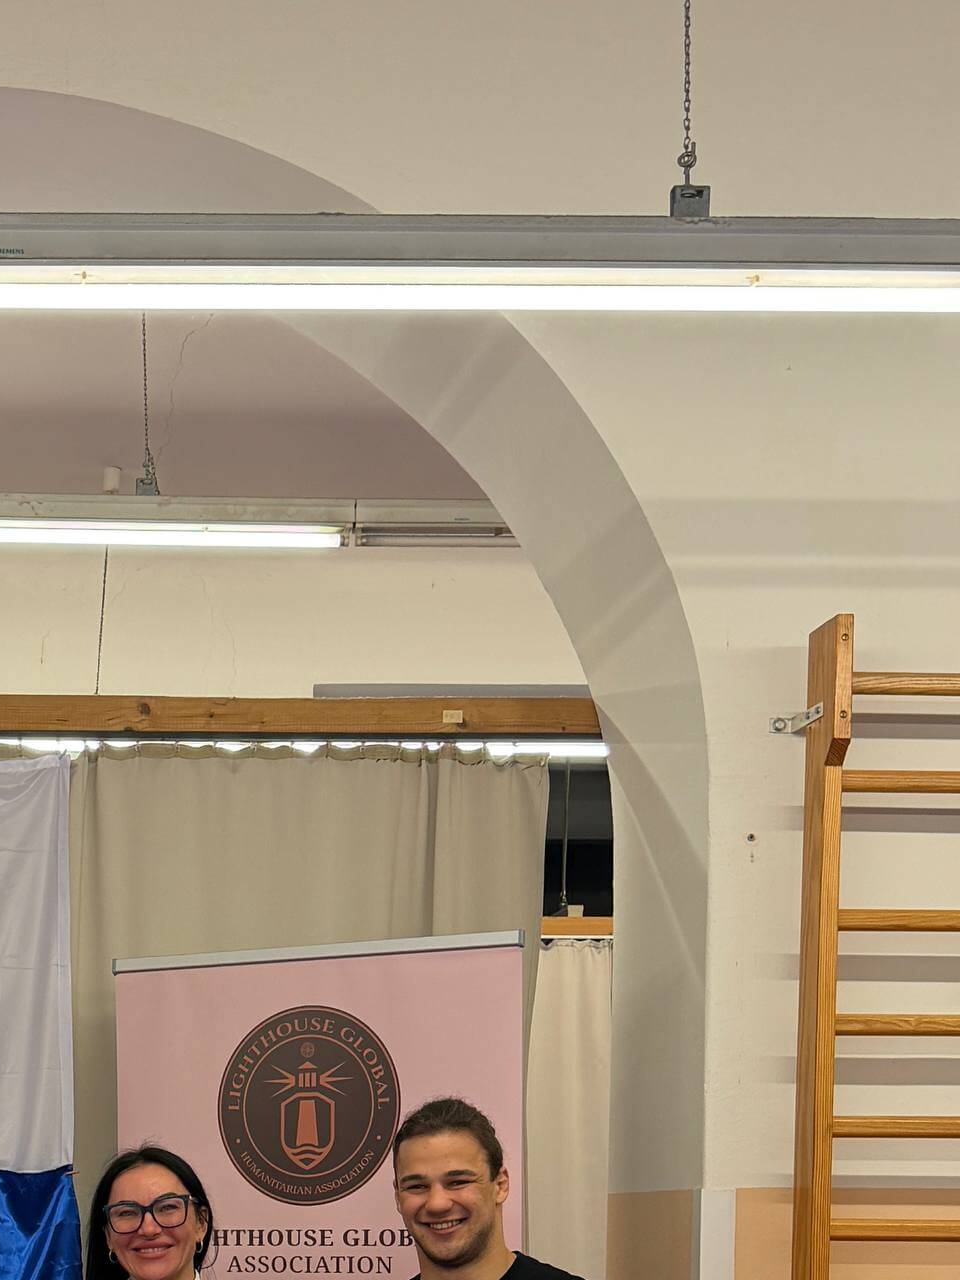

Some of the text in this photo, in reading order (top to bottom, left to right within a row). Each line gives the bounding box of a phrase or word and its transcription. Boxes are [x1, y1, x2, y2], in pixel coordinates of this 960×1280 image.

[228, 1017, 390, 1113] LIGHTHOUSE GLOBAL
[240, 1150, 376, 1195] HUMANITARIAN ASSOCIATION
[213, 1228, 414, 1247] HTHOUSE GLOB
[227, 1255, 393, 1274] ASSOCIATION
